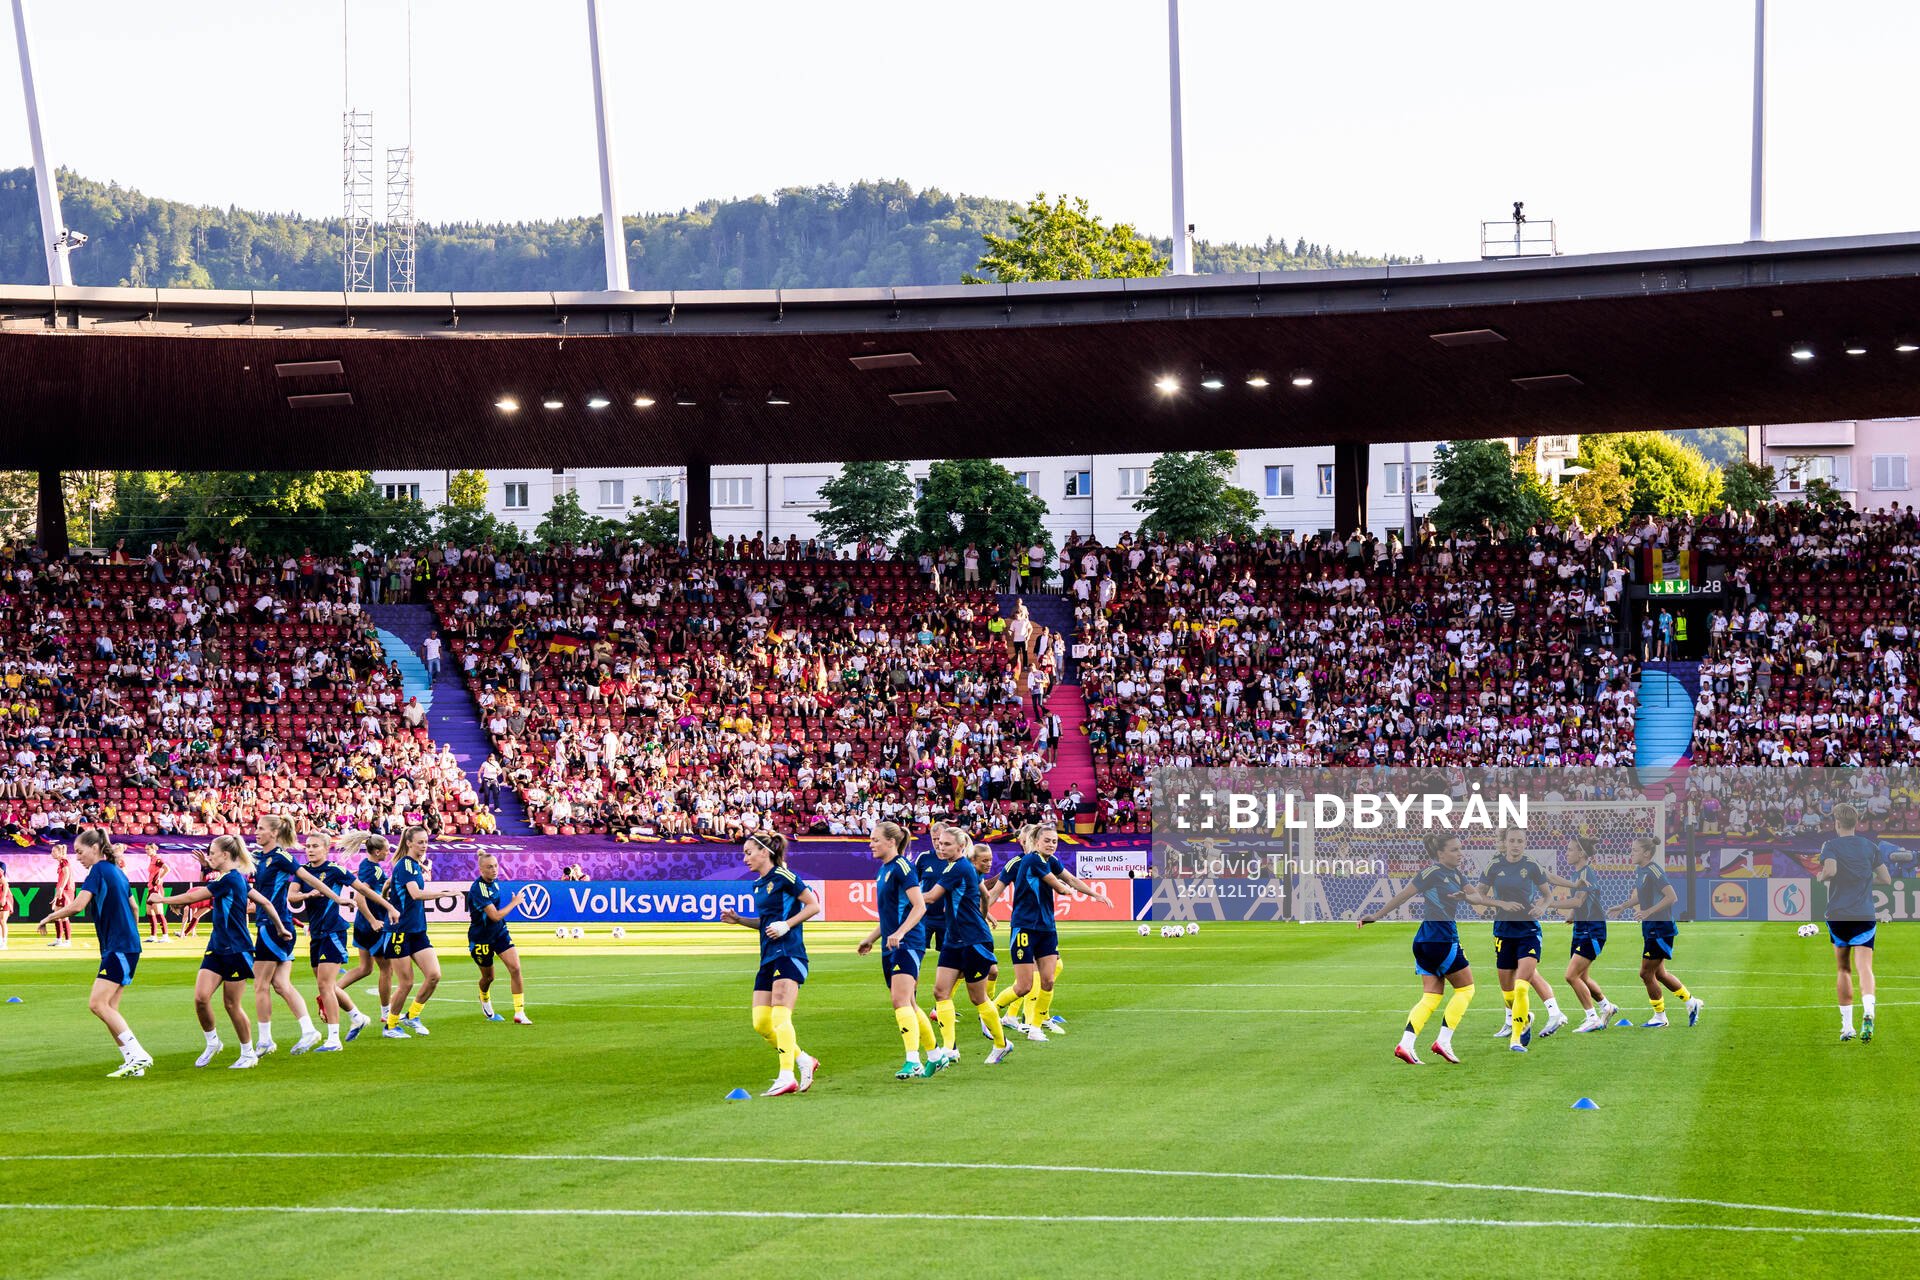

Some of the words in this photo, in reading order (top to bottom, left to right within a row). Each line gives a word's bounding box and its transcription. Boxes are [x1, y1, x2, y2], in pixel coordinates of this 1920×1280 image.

[569, 887, 755, 920] Volkswagen
[1136, 878, 1225, 920] AXA
[391, 932, 404, 944] 13
[1017, 933, 1028, 947] 18
[475, 944, 489, 955] 20
